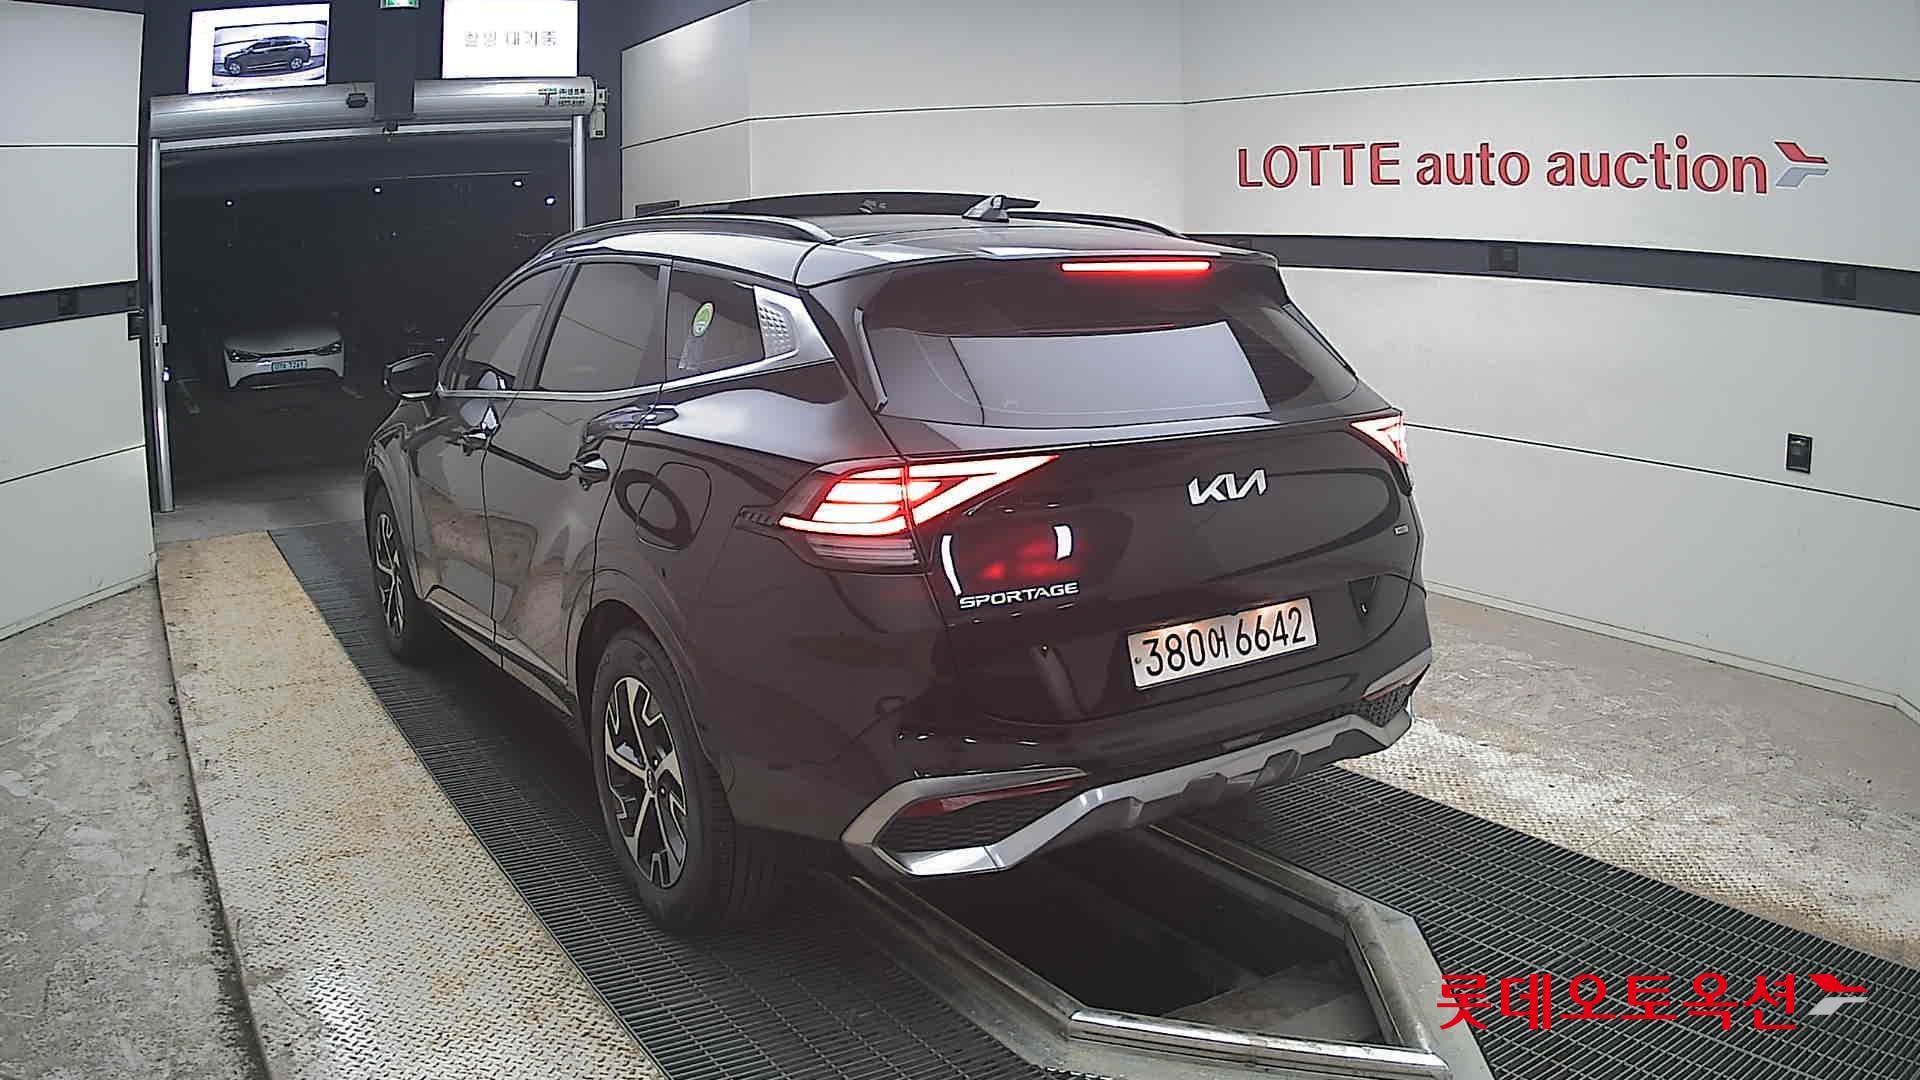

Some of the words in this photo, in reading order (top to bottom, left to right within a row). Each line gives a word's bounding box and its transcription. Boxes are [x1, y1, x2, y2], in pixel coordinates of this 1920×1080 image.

[1237, 142, 1401, 189] LOTTE
[1416, 143, 1531, 186] auto
[1546, 136, 1768, 194] auction
[959, 582, 1080, 609] SPORTAGE
[1235, 606, 1306, 656] 6642
